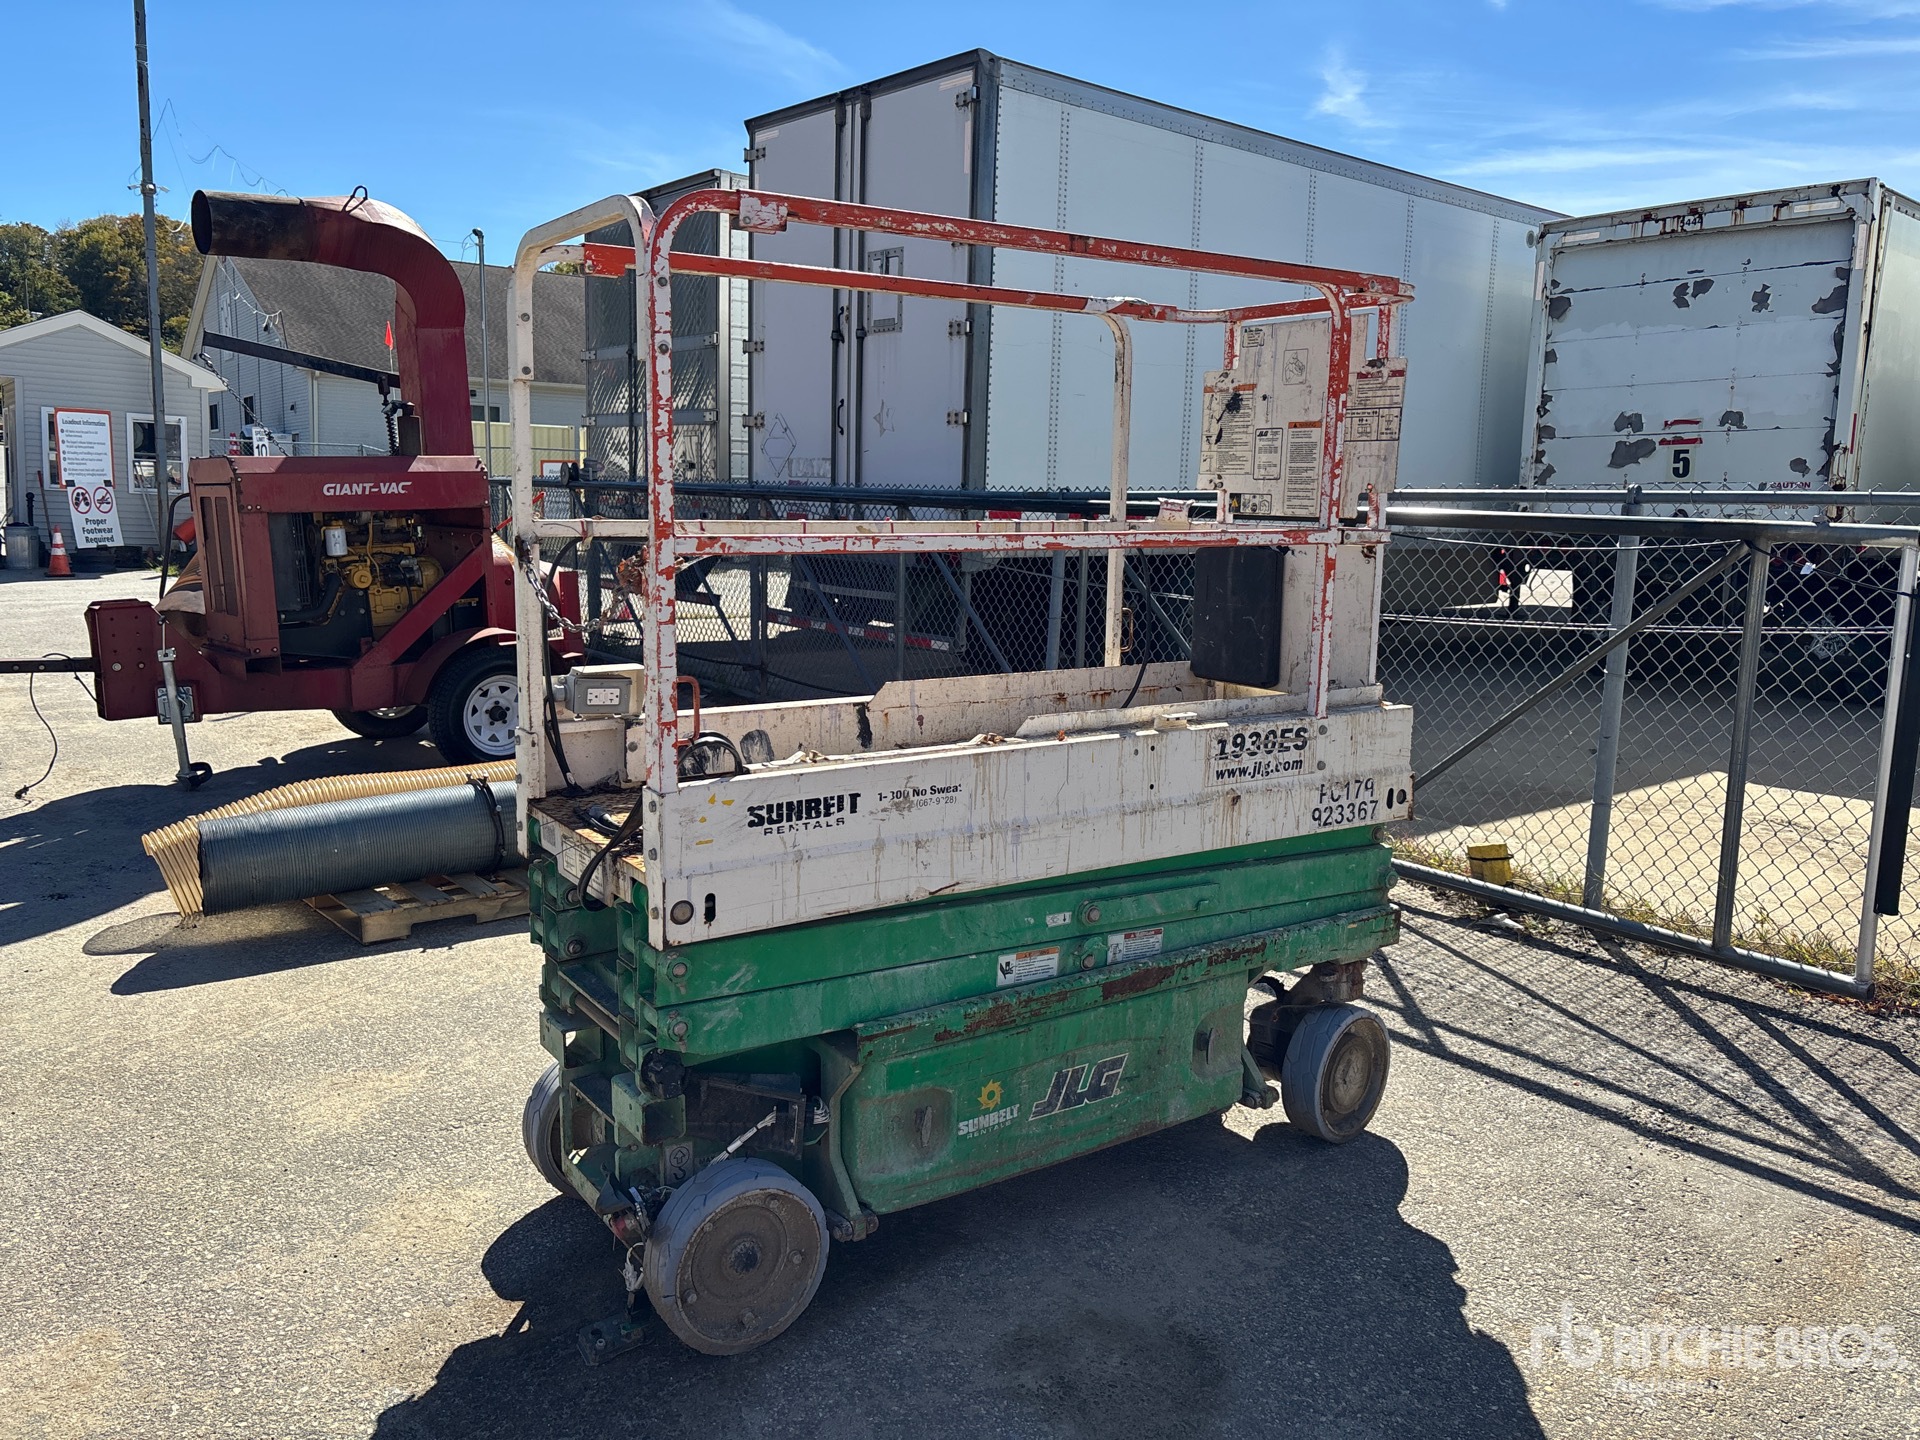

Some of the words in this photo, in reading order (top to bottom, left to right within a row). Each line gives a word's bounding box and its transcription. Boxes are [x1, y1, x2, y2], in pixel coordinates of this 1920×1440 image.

[255, 443, 268, 456] 10
[1672, 448, 1690, 479] 5
[322, 481, 412, 496] GIANT-VAC
[1770, 481, 1811, 489] CAUTON
[85, 517, 107, 526] Proper
[82, 527, 113, 535] Footwear
[85, 535, 115, 544] Required
[1214, 726, 1309, 761] 1930ES
[1215, 758, 1303, 780] www.jlg.com
[912, 788, 927, 798] No
[915, 796, 957, 808] (667-928)
[1311, 800, 1379, 827] 923367
[1028, 1052, 1129, 1122] JLG
[957, 1103, 1020, 1136] SUNBELT
